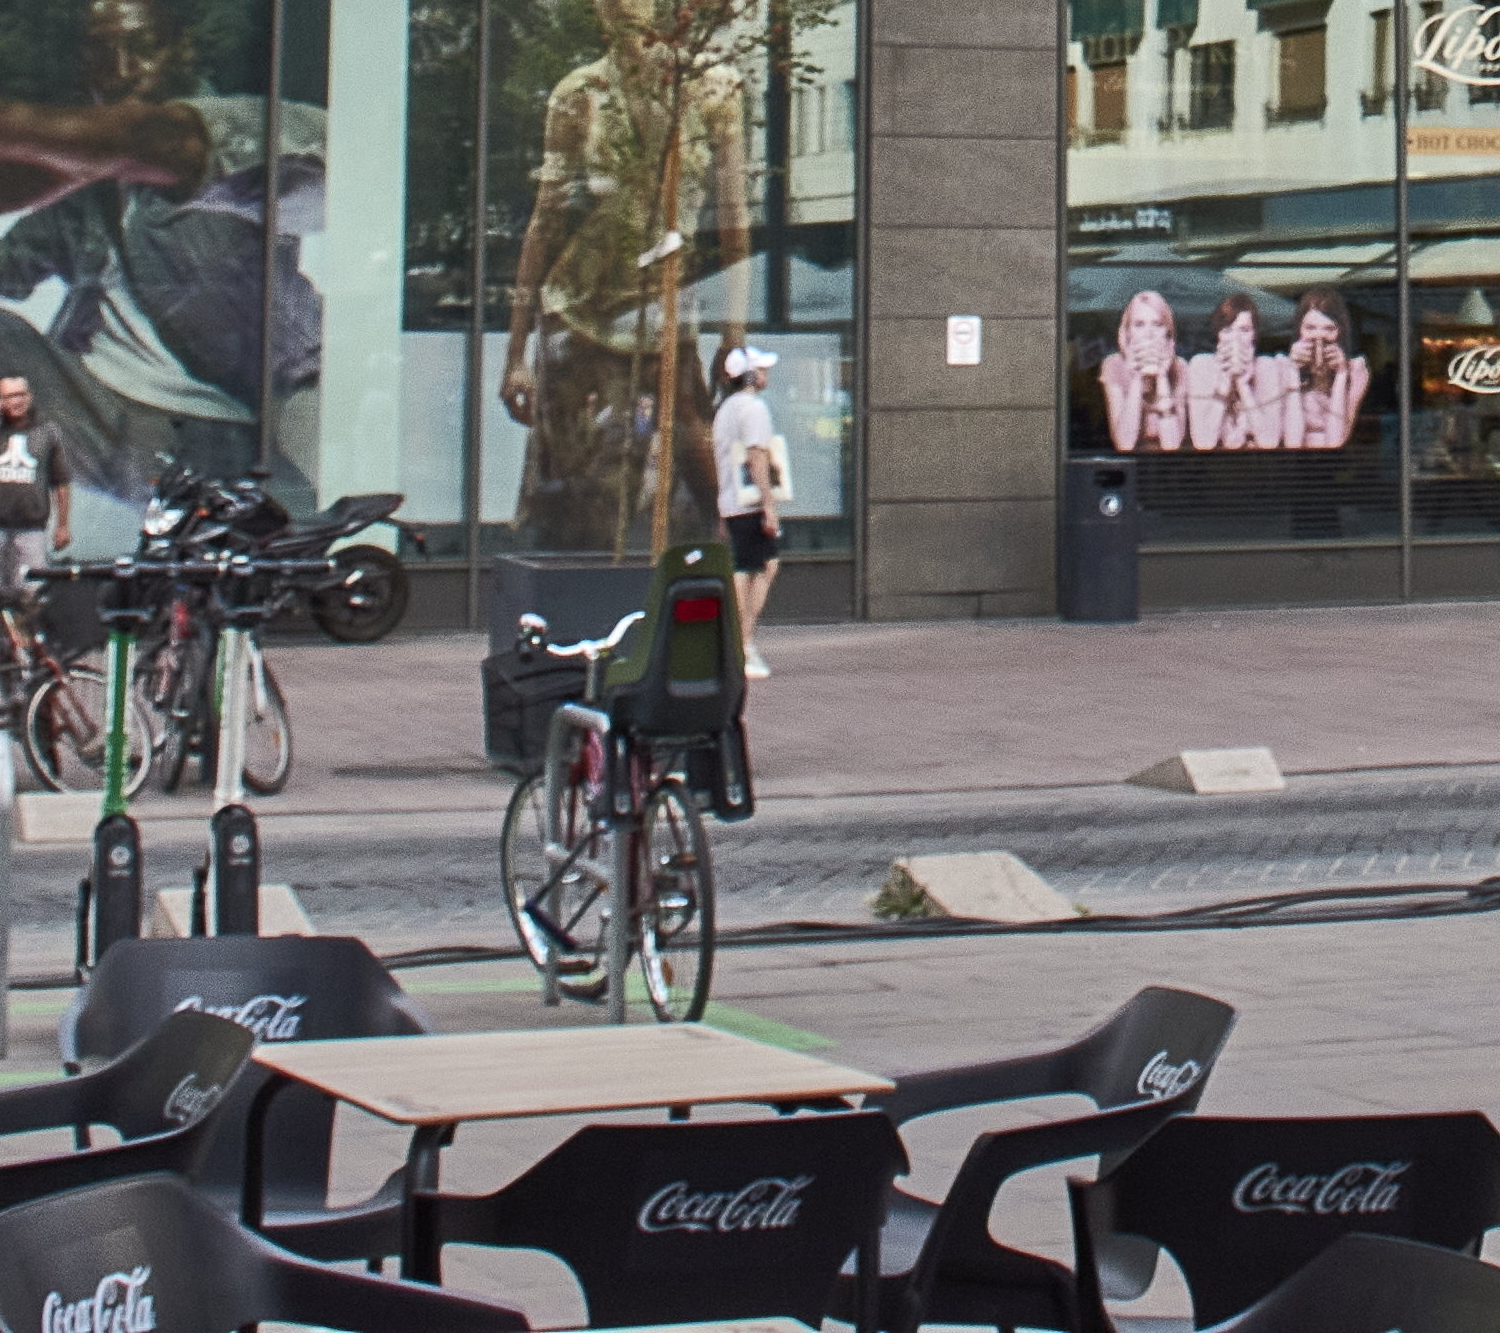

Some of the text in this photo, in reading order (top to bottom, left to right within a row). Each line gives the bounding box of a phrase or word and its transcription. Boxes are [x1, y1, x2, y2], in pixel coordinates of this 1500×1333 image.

[1415, 133, 1452, 152] HOT
[637, 1174, 815, 1235] Coca-Cola
[1232, 1160, 1414, 1216] Coca-Cola
